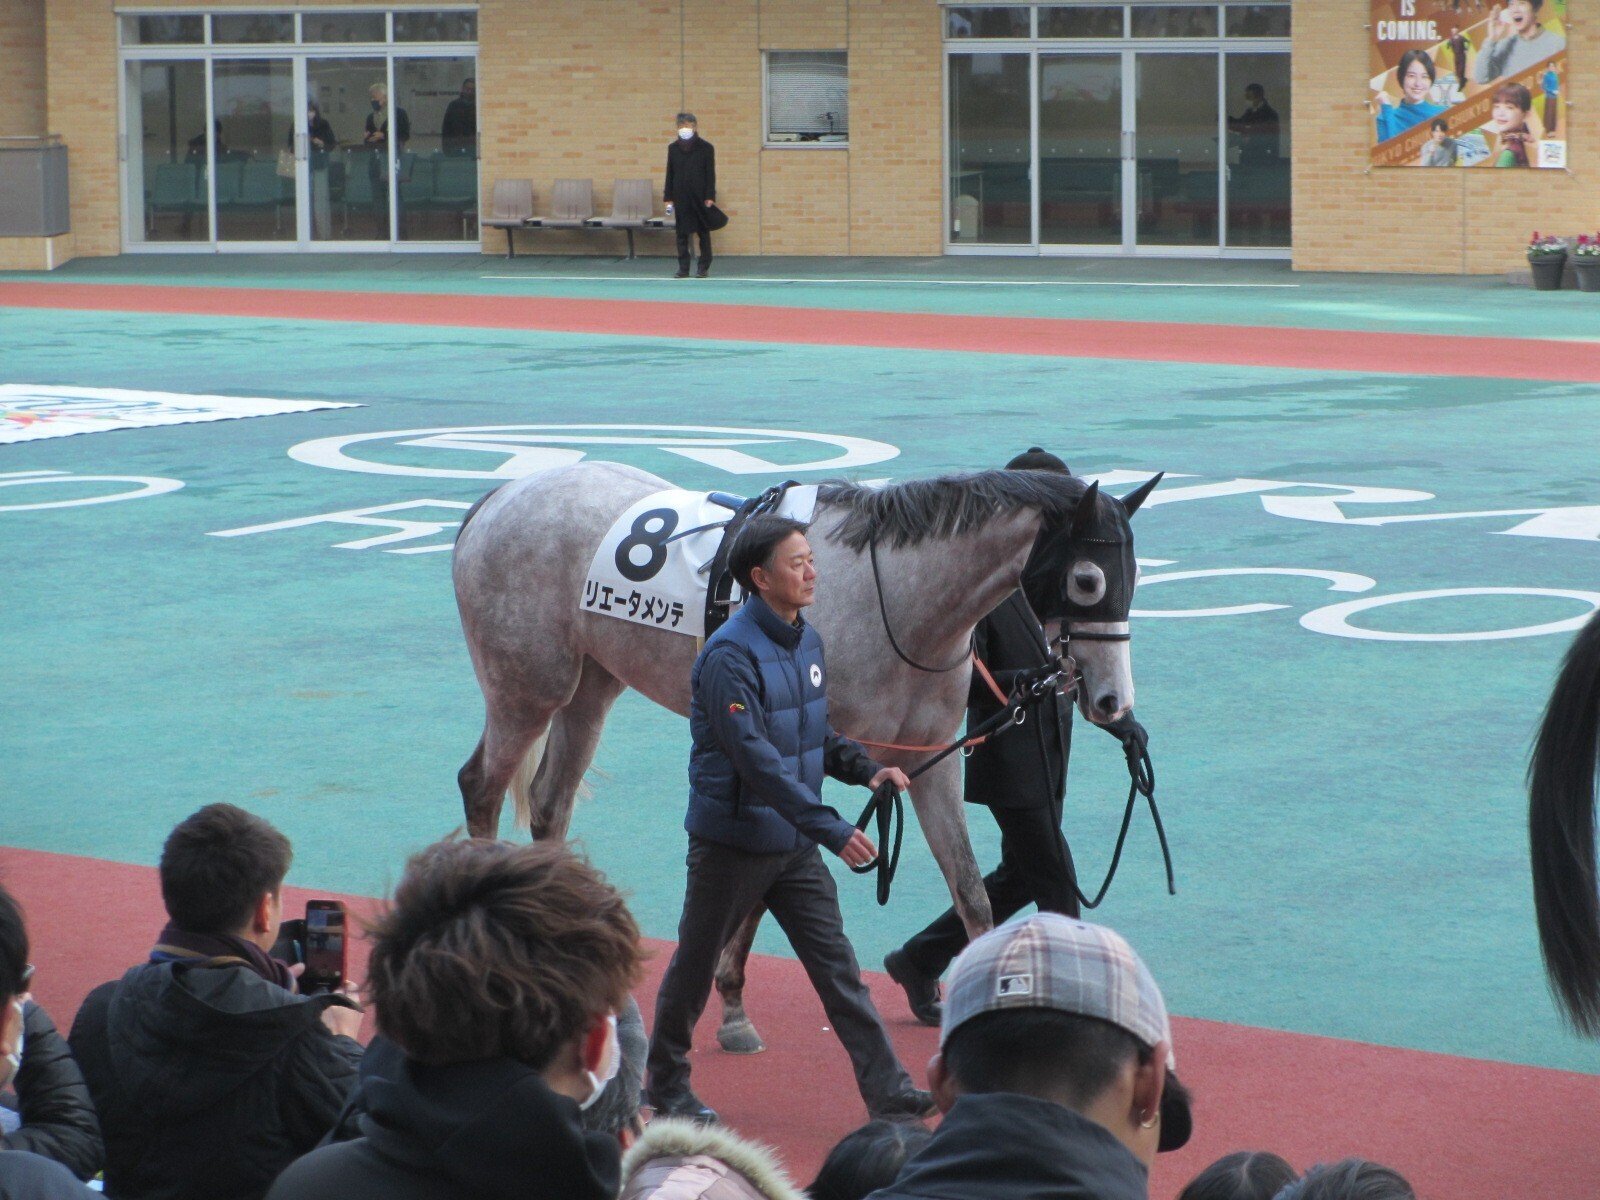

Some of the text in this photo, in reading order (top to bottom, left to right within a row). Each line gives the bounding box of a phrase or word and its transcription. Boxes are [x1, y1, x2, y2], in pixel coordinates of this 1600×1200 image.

[1401, 0, 1415, 16] IS
[1377, 20, 1442, 40] COMING.
[614, 507, 679, 582] 8
[586, 580, 684, 627] リエータメンテ
